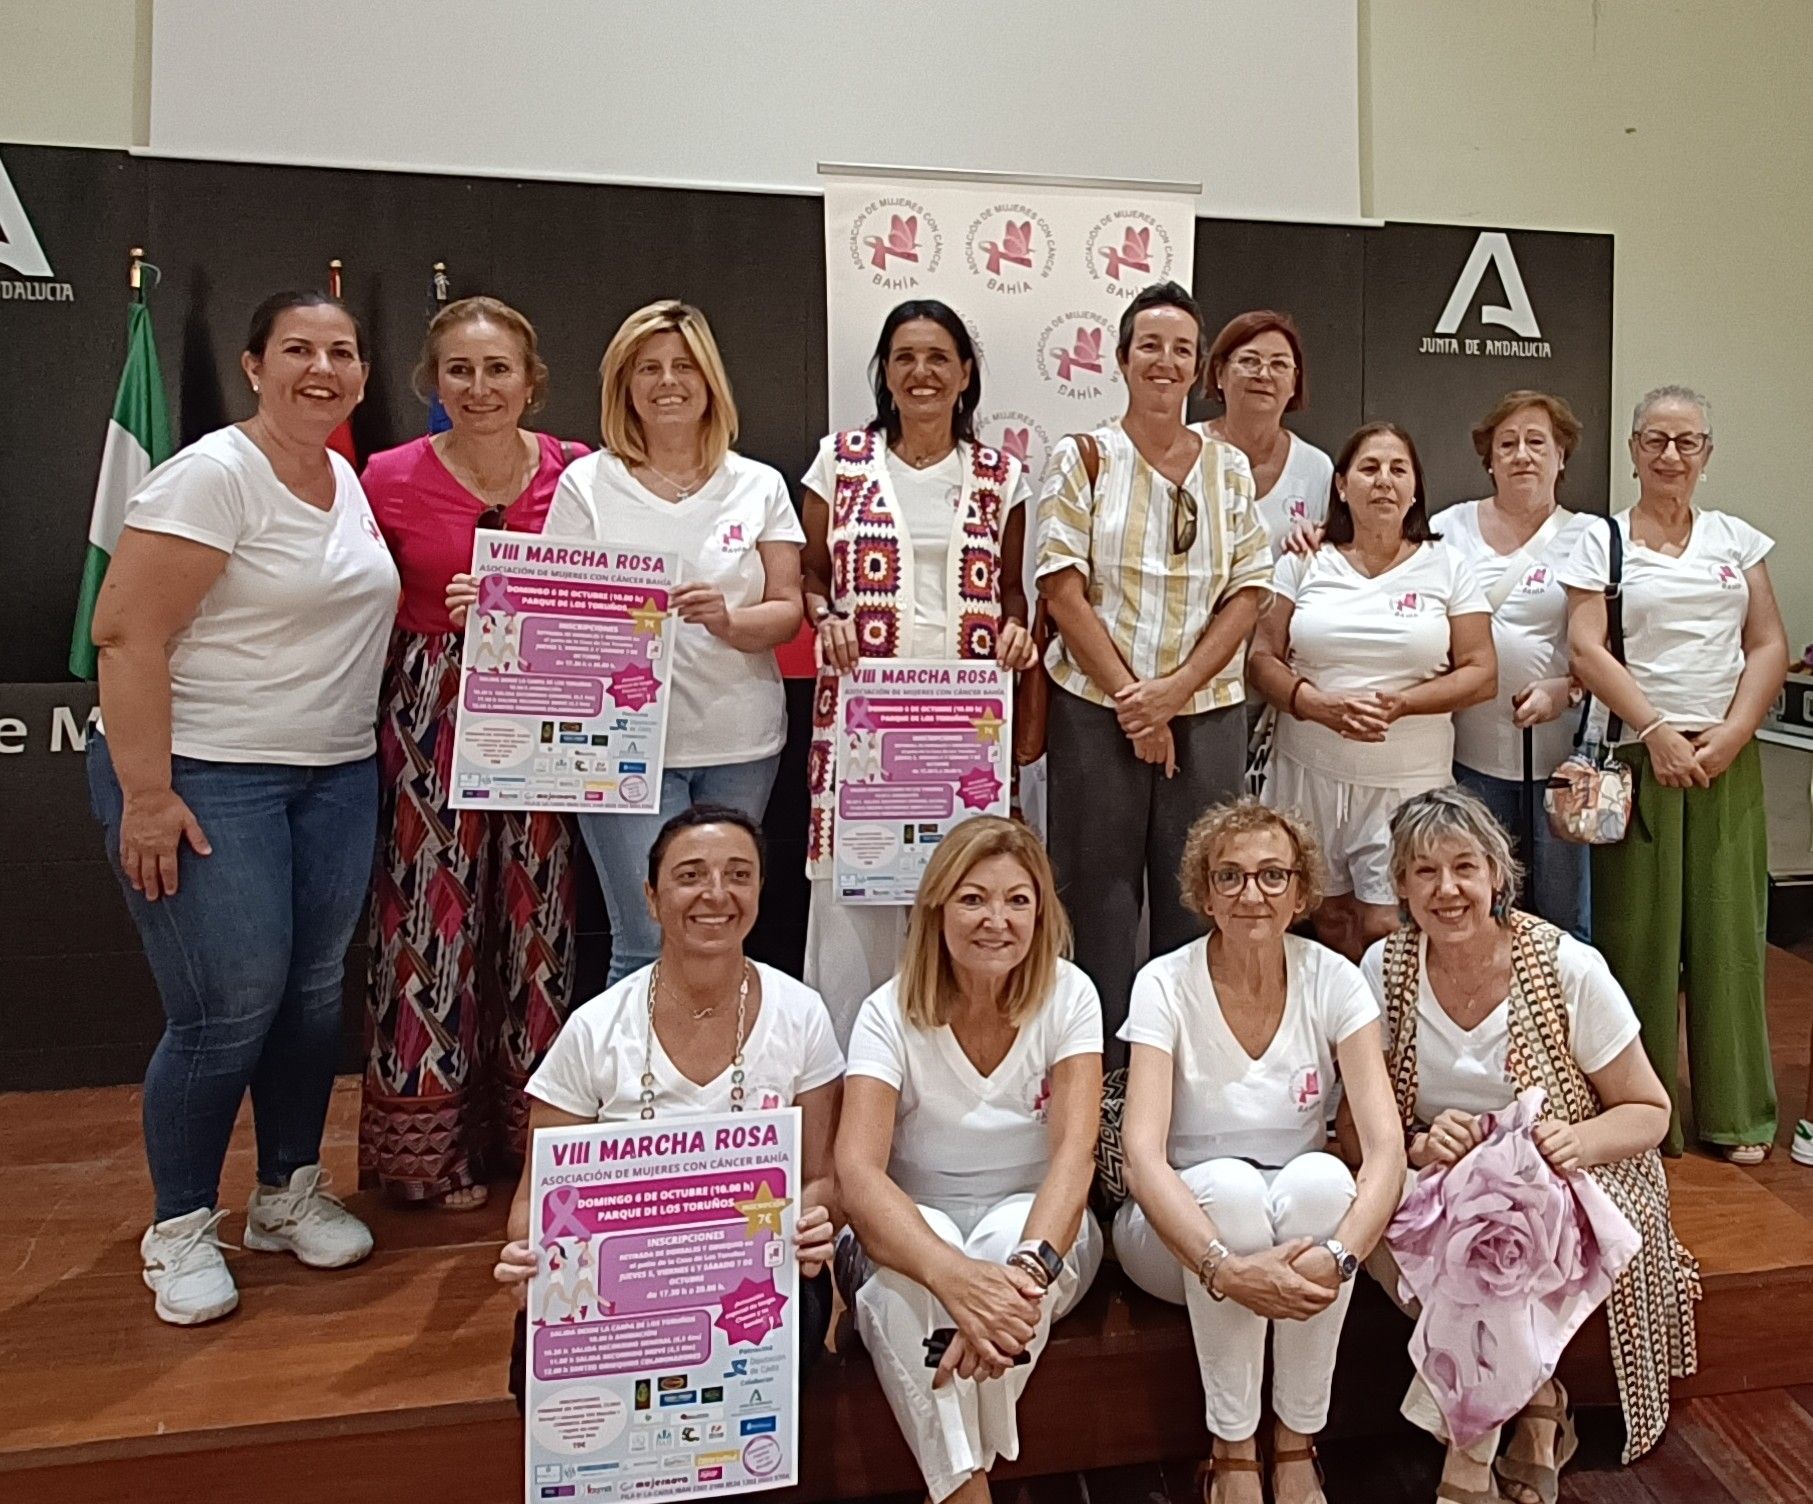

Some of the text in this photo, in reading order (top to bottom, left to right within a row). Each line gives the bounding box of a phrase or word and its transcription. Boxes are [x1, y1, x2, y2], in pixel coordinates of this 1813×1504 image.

[879, 198, 923, 214] MUJERES
[1419, 337, 1459, 354] JUNTA
[1465, 339, 1481, 355] DE
[490, 542, 665, 573] VIII MARCHA ROSA
[537, 569, 548, 577] DE
[551, 570, 588, 580] MUJERES
[590, 573, 608, 582] CON
[522, 597, 555, 608] PARQUE
[557, 599, 568, 608] DE
[570, 599, 586, 609] LOS
[558, 588, 568, 597] DE
[570, 590, 608, 601] OCTUBRE
[851, 669, 998, 684] VIII MARCHA ROSA
[552, 1124, 779, 1167] VIII MARCHA ROSA
[541, 1152, 789, 1187] ASOCIACIÓN DE MUJERES CON CÁNCER BAHÍA
[578, 1194, 633, 1209] DOMINGO
[644, 1191, 657, 1202] DE
[660, 1186, 708, 1200] OCTUBRE
[597, 1197, 736, 1221] PARQUE DE LOS TORUÑOS
[758, 1213, 772, 1225] 7€
[647, 1230, 725, 1247] INSCRIPCIONES
